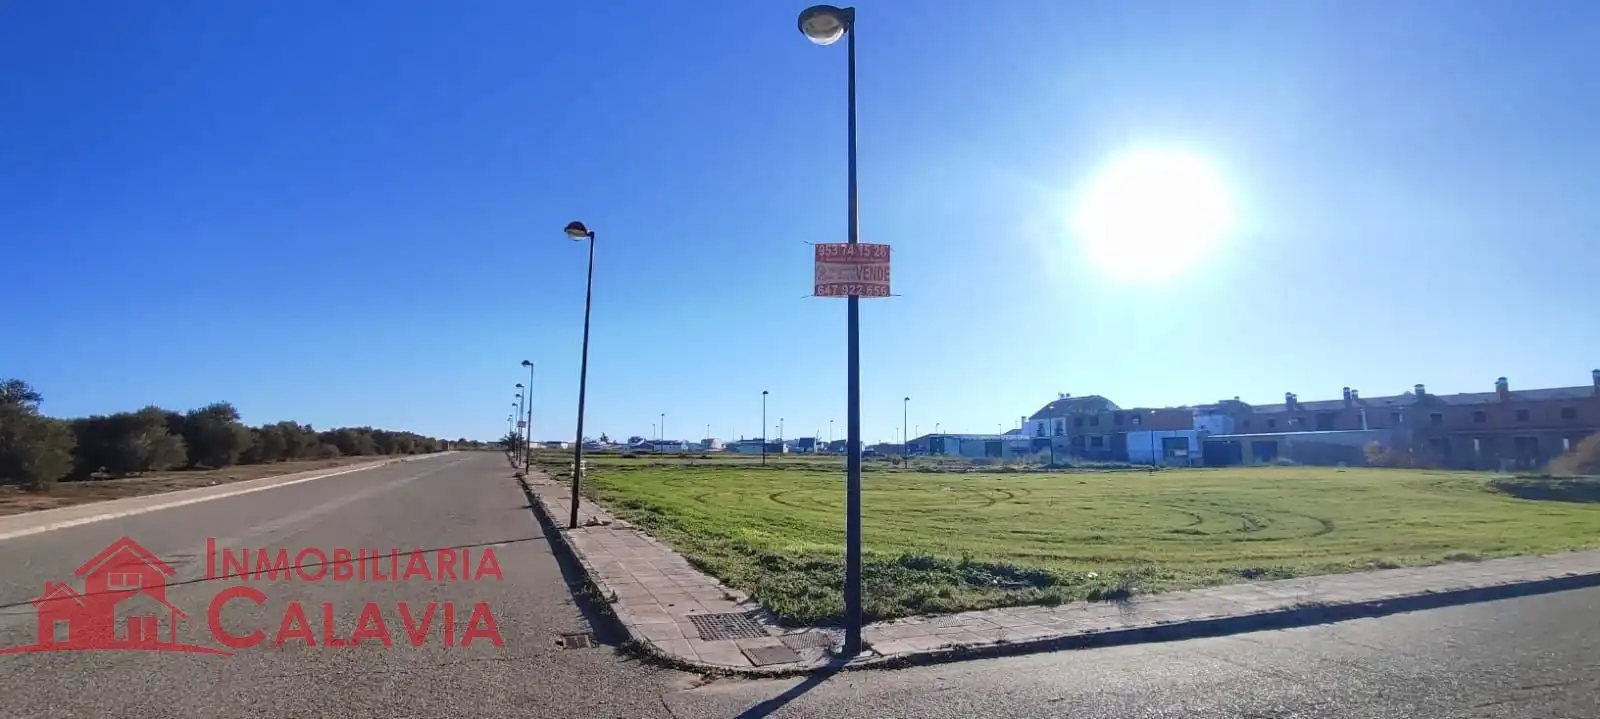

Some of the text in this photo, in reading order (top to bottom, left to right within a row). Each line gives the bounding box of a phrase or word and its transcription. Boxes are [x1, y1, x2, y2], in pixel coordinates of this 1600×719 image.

[818, 244, 838, 256] 953
[841, 244, 854, 256] 74
[860, 245, 871, 257] 15
[857, 264, 890, 281] VENDE
[817, 284, 838, 295] 647
[842, 284, 863, 295] 922
